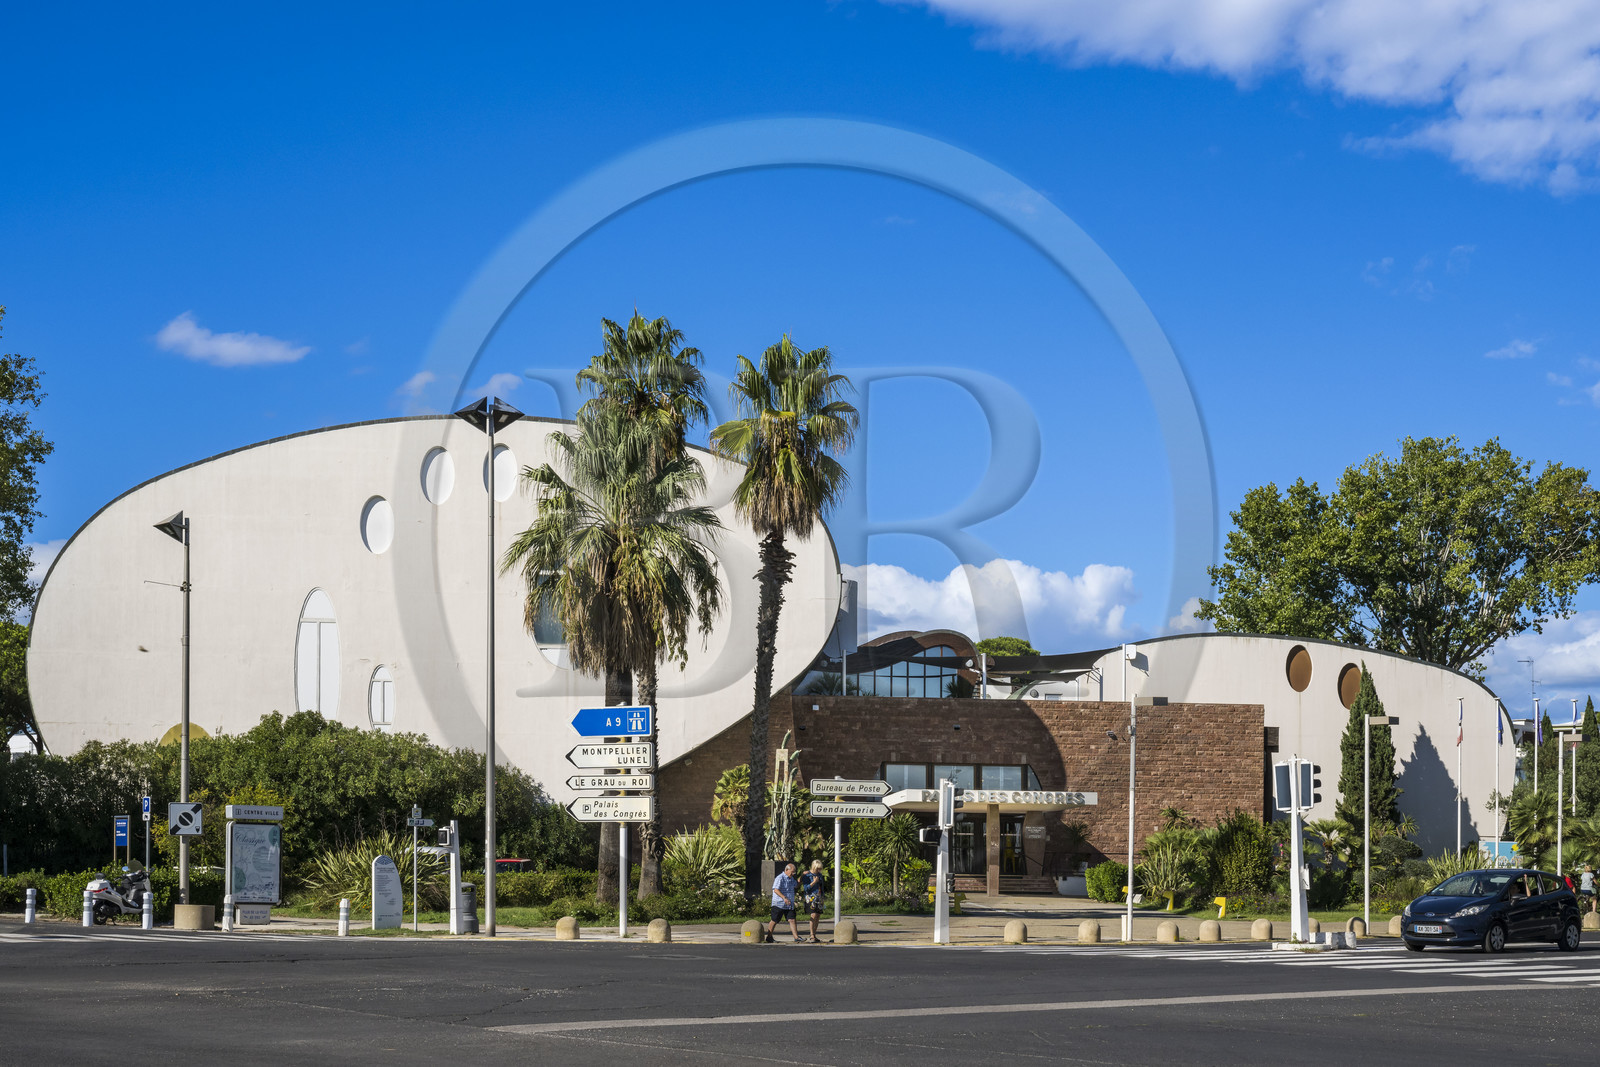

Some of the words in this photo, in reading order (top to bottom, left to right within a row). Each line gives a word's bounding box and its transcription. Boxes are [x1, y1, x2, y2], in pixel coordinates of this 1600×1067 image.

[606, 717, 612, 727] A
[615, 717, 621, 727] 9
[582, 747, 648, 756] MONTPELLIER
[617, 756, 648, 764] LUNEL
[575, 779, 585, 787] LE
[591, 778, 615, 787] GRAU
[631, 778, 648, 786] ROI
[815, 783, 843, 792] Bureau
[846, 784, 856, 792] de
[858, 784, 881, 793] Poste
[921, 788, 975, 803] PAS
[978, 790, 1009, 803] DES
[593, 800, 619, 808] Palais
[593, 810, 608, 818] des
[613, 809, 647, 819] Congrès
[816, 805, 875, 814] Gendarmerie
